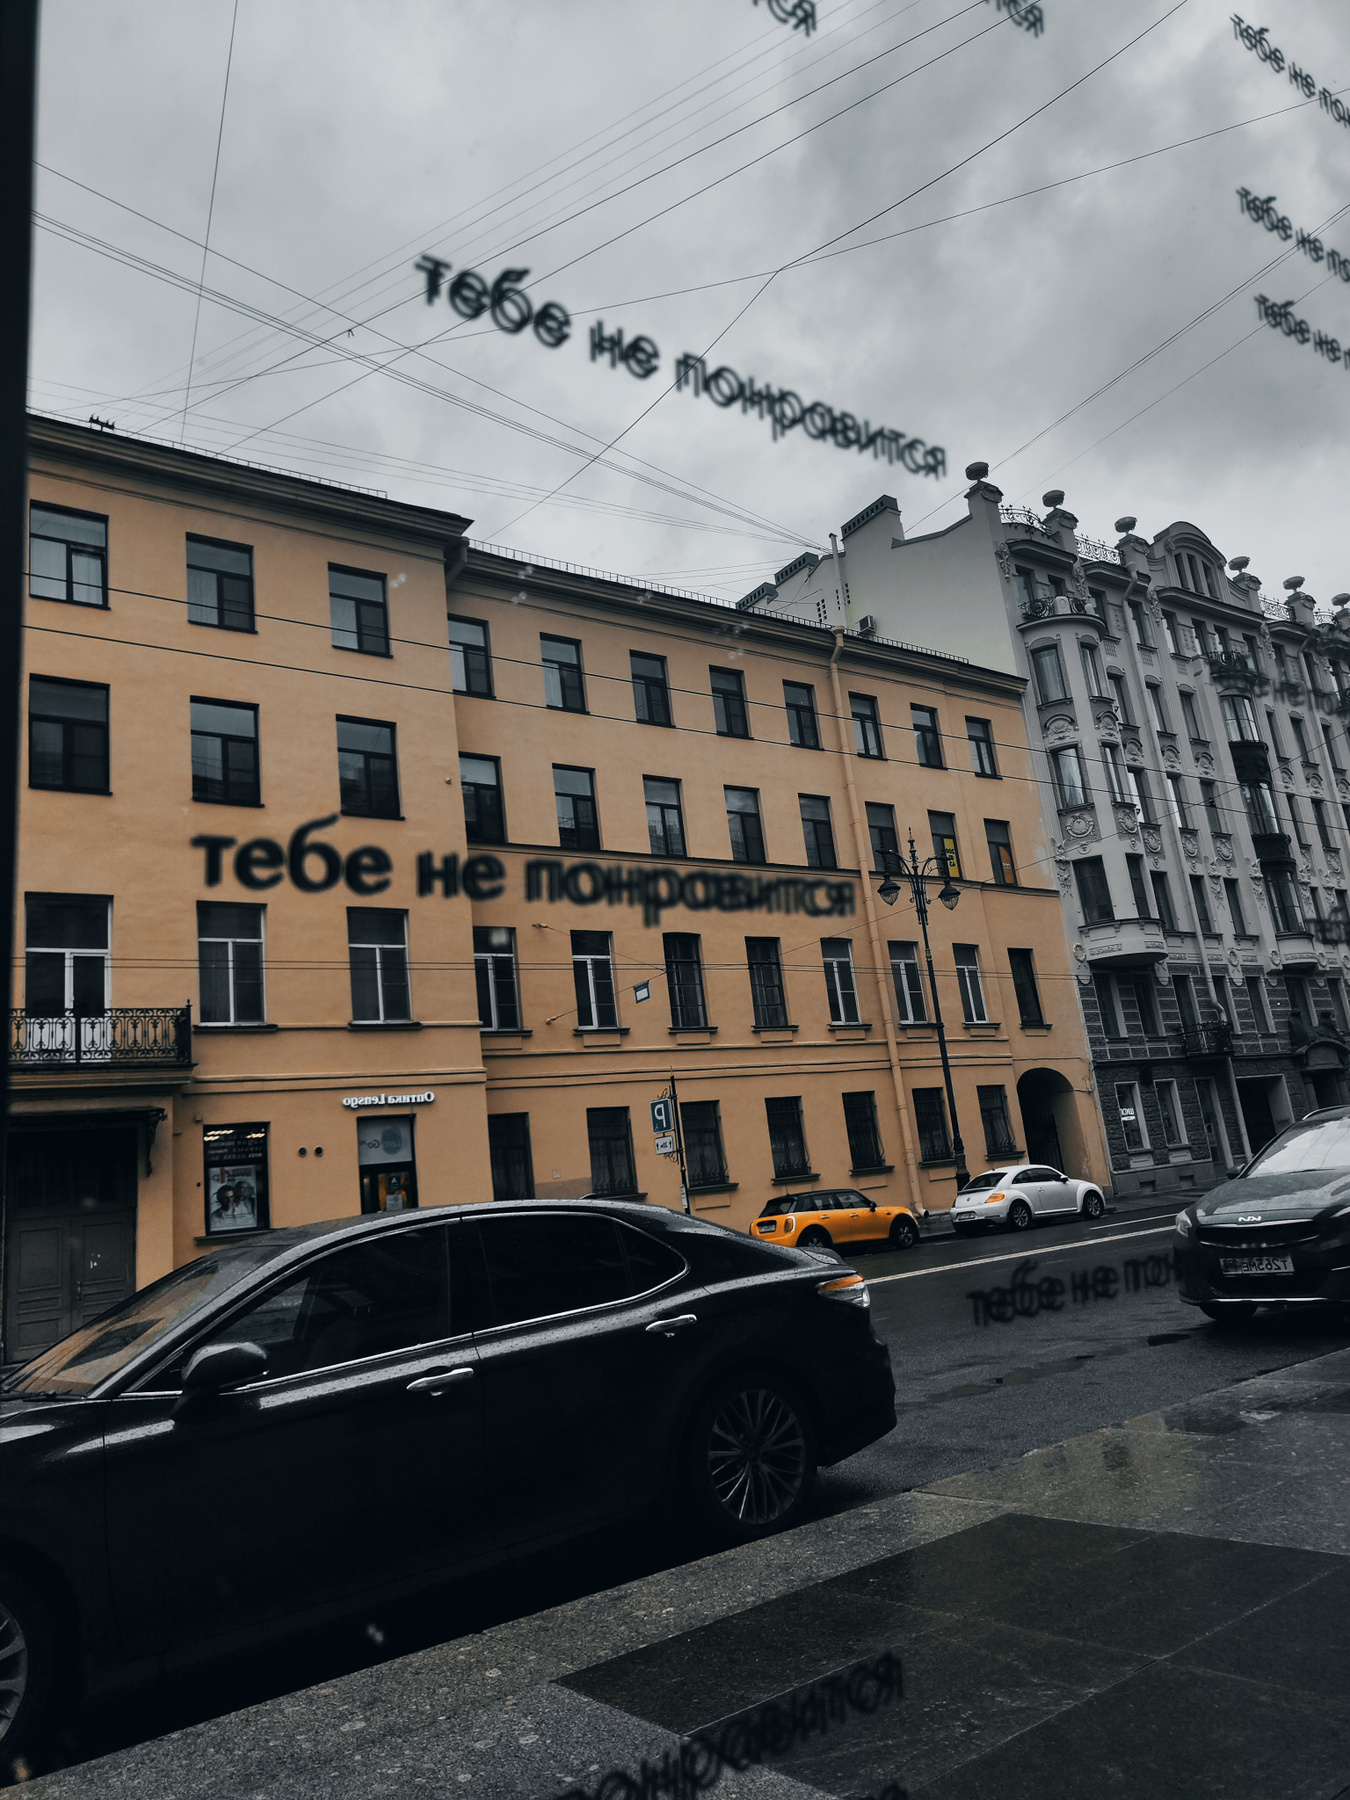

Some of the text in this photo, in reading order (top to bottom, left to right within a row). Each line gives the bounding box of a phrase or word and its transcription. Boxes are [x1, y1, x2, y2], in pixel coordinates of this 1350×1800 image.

[1230, 13, 1285, 74] тебе
[1288, 62, 1316, 98] не
[1236, 186, 1292, 241] тебе
[1296, 228, 1324, 262] не
[1254, 293, 1310, 344] тебе
[414, 254, 946, 480] тебе не понравится
[190, 813, 856, 928] тебе не понравится
[966, 1259, 1066, 1327] тебе
[1071, 1265, 1119, 1305] не
